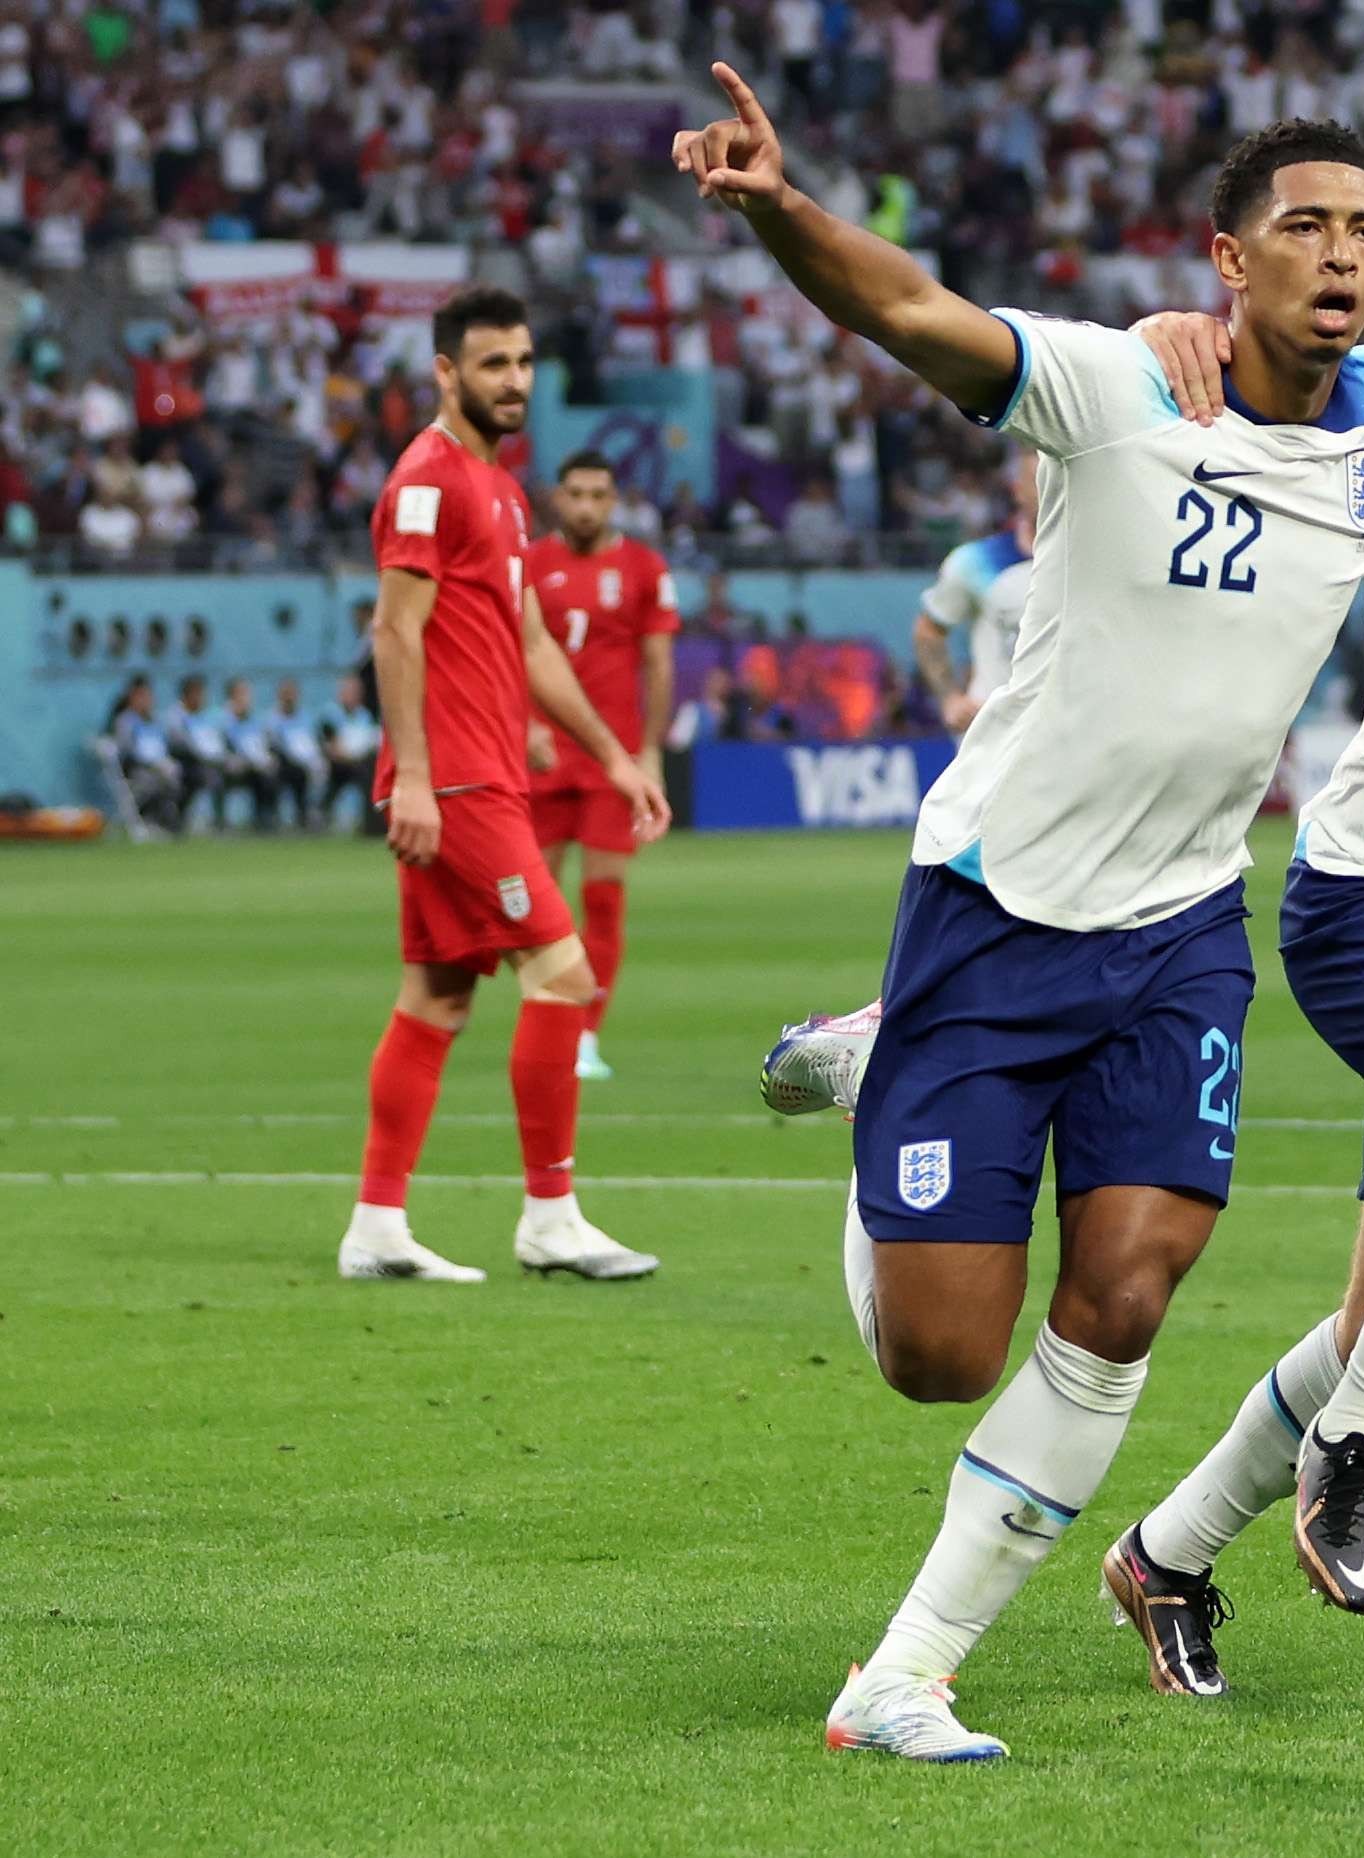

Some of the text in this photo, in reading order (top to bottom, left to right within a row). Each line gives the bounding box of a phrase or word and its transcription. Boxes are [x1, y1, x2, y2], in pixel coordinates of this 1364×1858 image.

[1168, 487, 1263, 593] 22
[786, 744, 919, 825] VISA
[1198, 1026, 1240, 1136] 2
